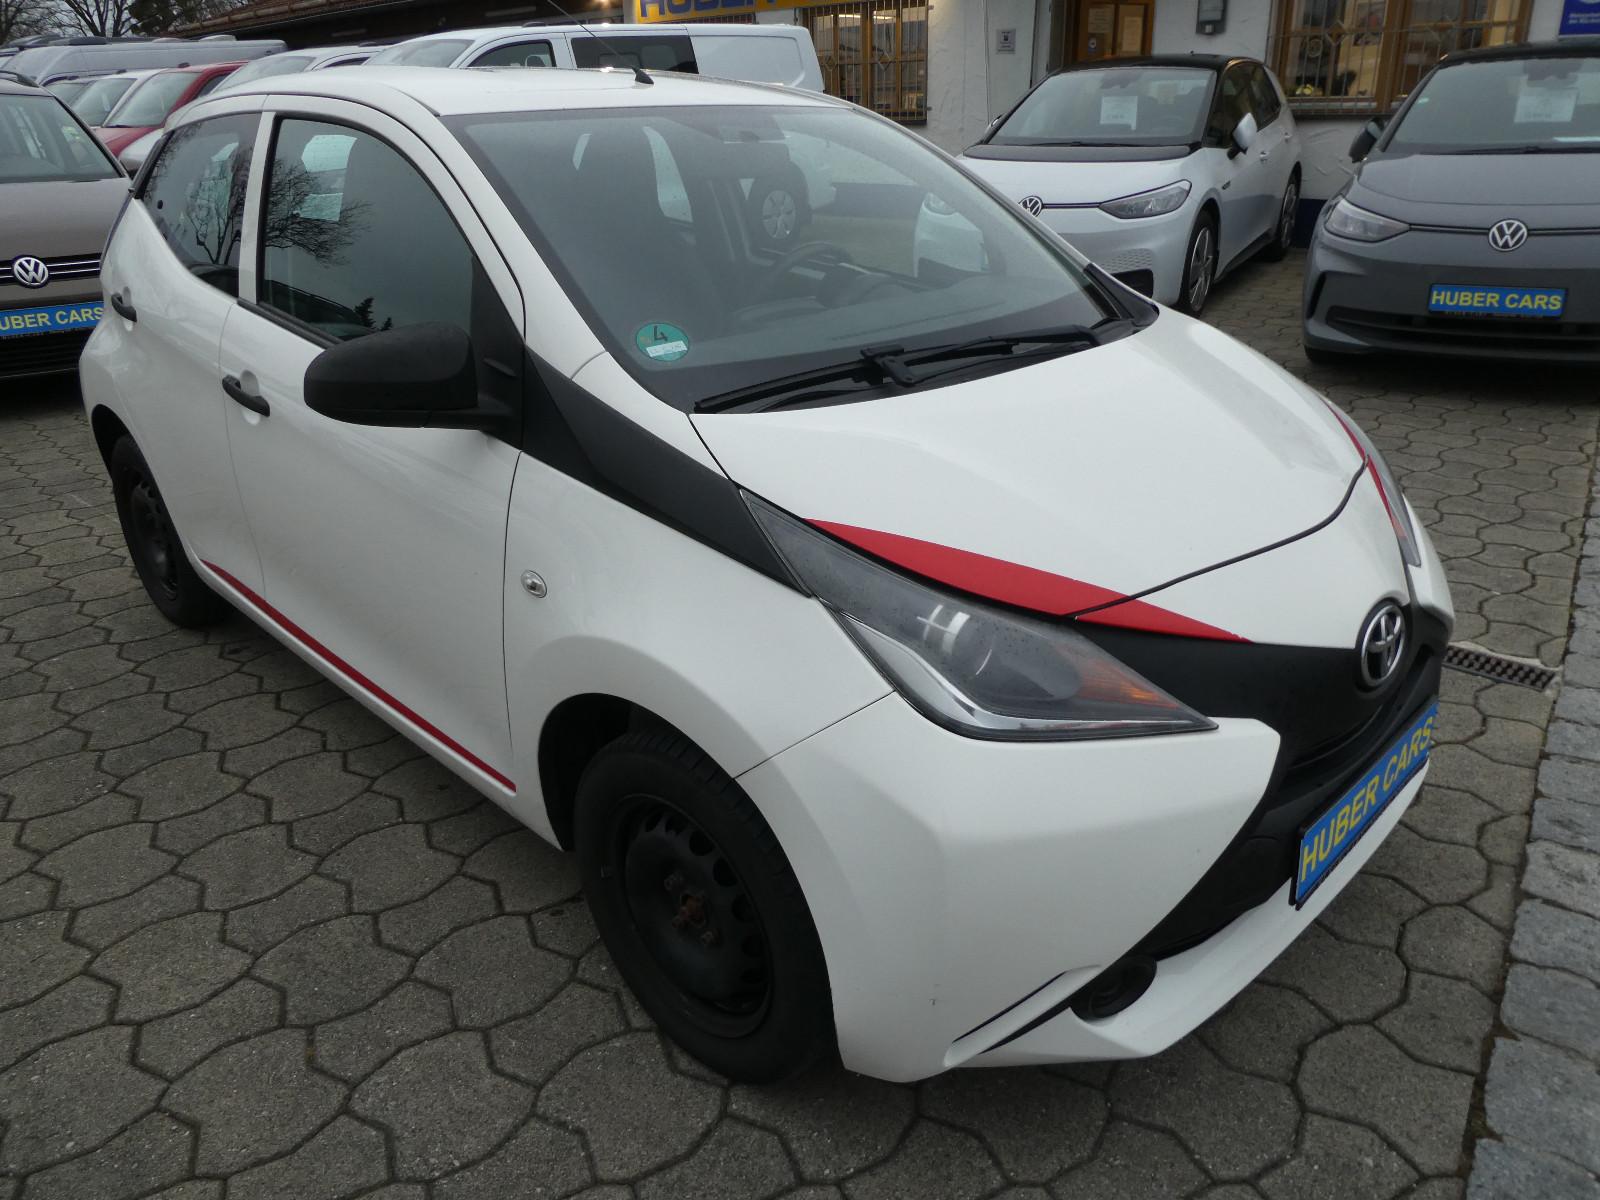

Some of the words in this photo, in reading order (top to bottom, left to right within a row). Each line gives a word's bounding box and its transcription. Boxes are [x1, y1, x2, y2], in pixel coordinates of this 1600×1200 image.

[1489, 220, 1528, 251] VW
[14, 257, 48, 285] VW
[1431, 291, 1500, 307] HUBER
[1505, 294, 1562, 310] CARS
[55, 307, 104, 325] CARS
[653, 325, 668, 342] 4
[1301, 775, 1380, 881] HUBER
[1383, 717, 1433, 792] CARS
